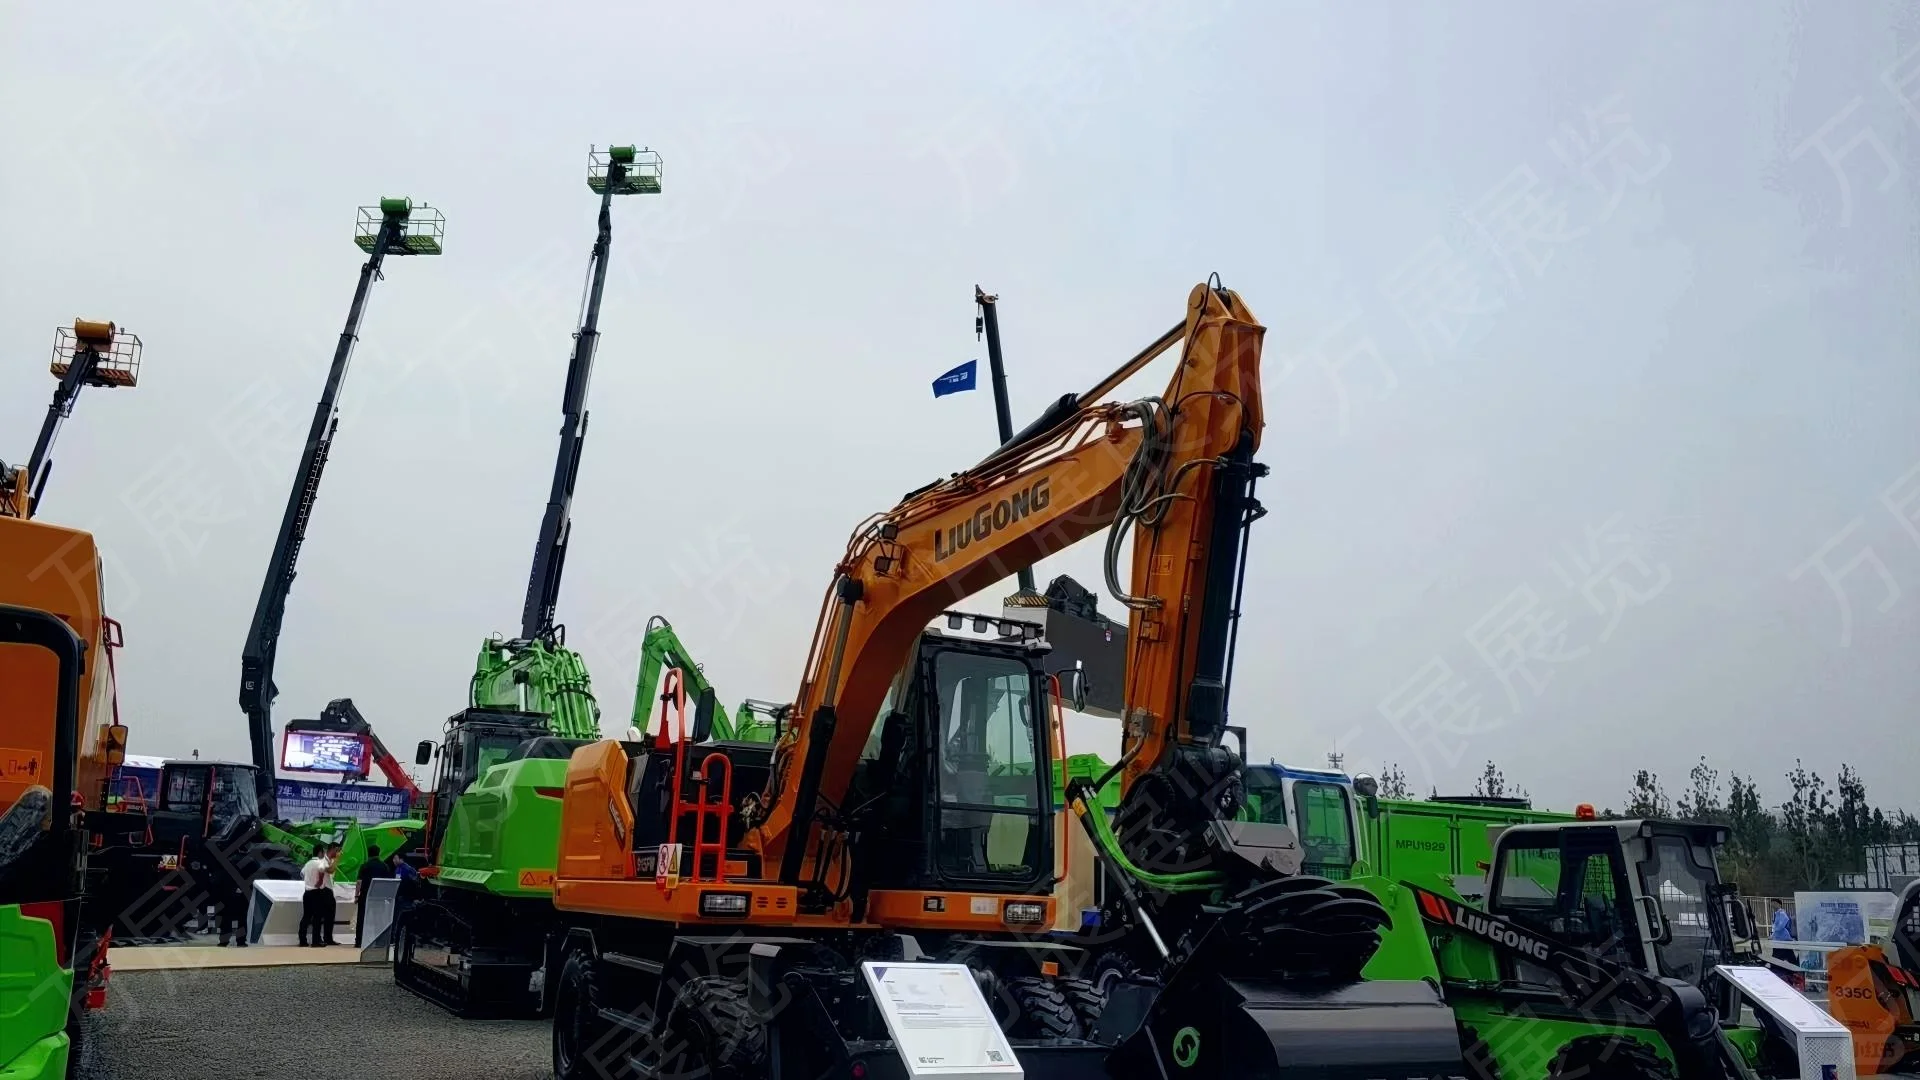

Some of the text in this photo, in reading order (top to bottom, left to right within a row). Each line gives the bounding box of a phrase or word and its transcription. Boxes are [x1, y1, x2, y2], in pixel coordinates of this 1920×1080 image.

[934, 476, 1050, 562] LIUGONG
[1395, 839, 1446, 852] MPU1929
[1455, 906, 1549, 961] LIUGONG
[1835, 985, 1873, 999] 335C
